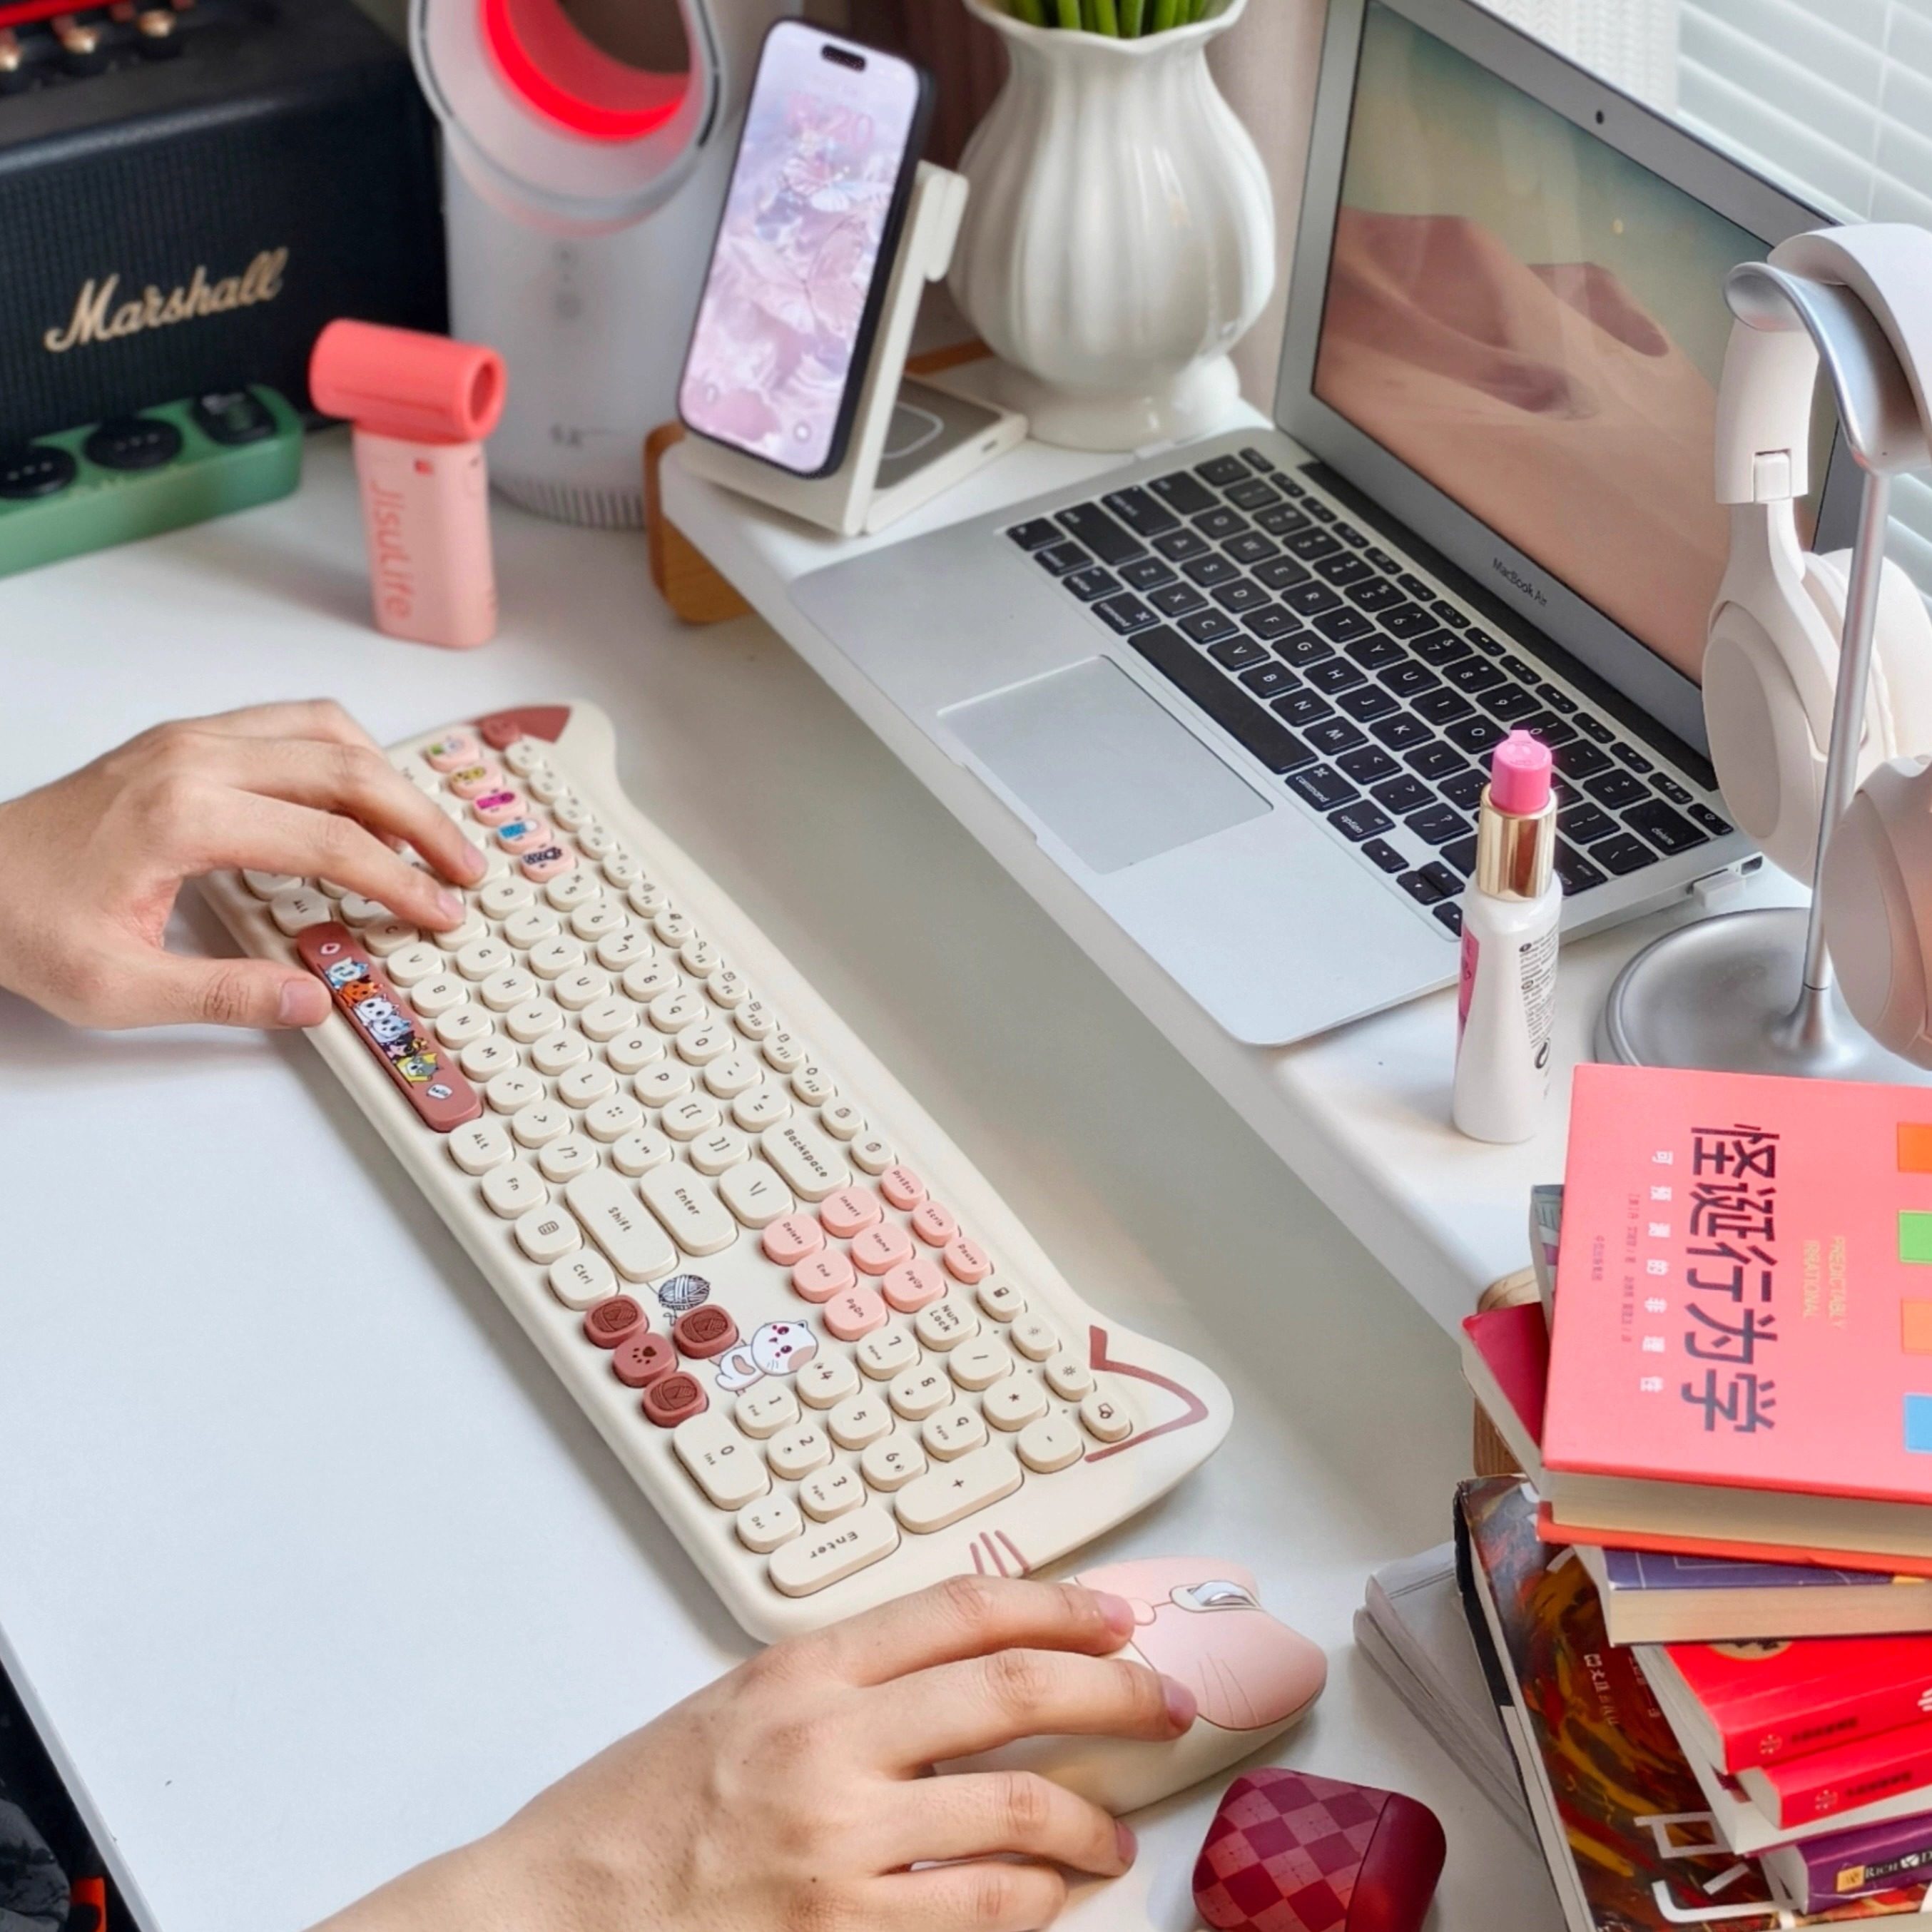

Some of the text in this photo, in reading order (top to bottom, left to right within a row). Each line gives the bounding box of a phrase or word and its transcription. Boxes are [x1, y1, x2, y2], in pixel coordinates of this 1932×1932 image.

[45, 247, 288, 352] Marshall
[1493, 557, 1533, 598] MacBook
[1170, 594, 1186, 603] X
[1234, 589, 1247, 598] D
[1306, 592, 1319, 601] R
[1201, 620, 1216, 629] C
[1264, 616, 1280, 624] F
[1338, 618, 1351, 626] T
[1233, 646, 1246, 655] V
[1298, 642, 1313, 651] G
[1370, 644, 1385, 654] Y
[1263, 673, 1277, 682] B
[1328, 669, 1344, 679] H
[1402, 671, 1418, 681] U
[1294, 701, 1311, 711] N
[1326, 728, 1345, 741] M
[1394, 725, 1410, 735] K
[1470, 728, 1485, 736] O
[1429, 754, 1442, 763] L
[1295, 775, 1330, 803] command
[1340, 815, 1363, 833] option
[501, 888, 514, 897] R
[527, 917, 539, 925] T
[591, 915, 604, 924] 6
[479, 950, 492, 958] G
[551, 947, 564, 956] Y
[617, 944, 630, 954] 7
[407, 955, 423, 964] V
[502, 980, 516, 989] H
[576, 977, 590, 986] U
[644, 975, 658, 985] 8
[432, 985, 446, 994] B
[603, 1009, 616, 1017] I
[669, 1006, 682, 1015] 9
[457, 1016, 470, 1025] N
[554, 1040, 568, 1051] K
[629, 1040, 642, 1049] O
[482, 1047, 497, 1058] M
[580, 1074, 594, 1084] L
[656, 1072, 670, 1082] P
[783, 1128, 828, 1178] Backspace
[507, 1178, 519, 1191] Fn
[674, 1187, 701, 1216] Enter
[839, 1194, 861, 1217] Insert
[608, 1206, 633, 1233] Shift
[782, 1221, 804, 1245] Delete
[872, 1232, 891, 1253] Home
[957, 1244, 978, 1266] Pause
[573, 1263, 594, 1285] Ctrl
[815, 1263, 831, 1278] End
[1680, 1123, 1780, 1433] 怪诞行为学
[1829, 1235, 1846, 1330] PREDICTABLY
[942, 1304, 961, 1326] Num
[889, 1336, 902, 1347] 7
[820, 1370, 834, 1381] 4
[921, 1376, 936, 1388] 8
[768, 1396, 782, 1405] 1
[853, 1410, 868, 1421] 5
[956, 1416, 970, 1428] 9
[799, 1435, 815, 1447] 2
[720, 1445, 735, 1456] 0
[885, 1453, 900, 1462] 6
[833, 1475, 848, 1488] 3
[751, 1516, 765, 1530] Del
[810, 1530, 858, 1560] Enter
